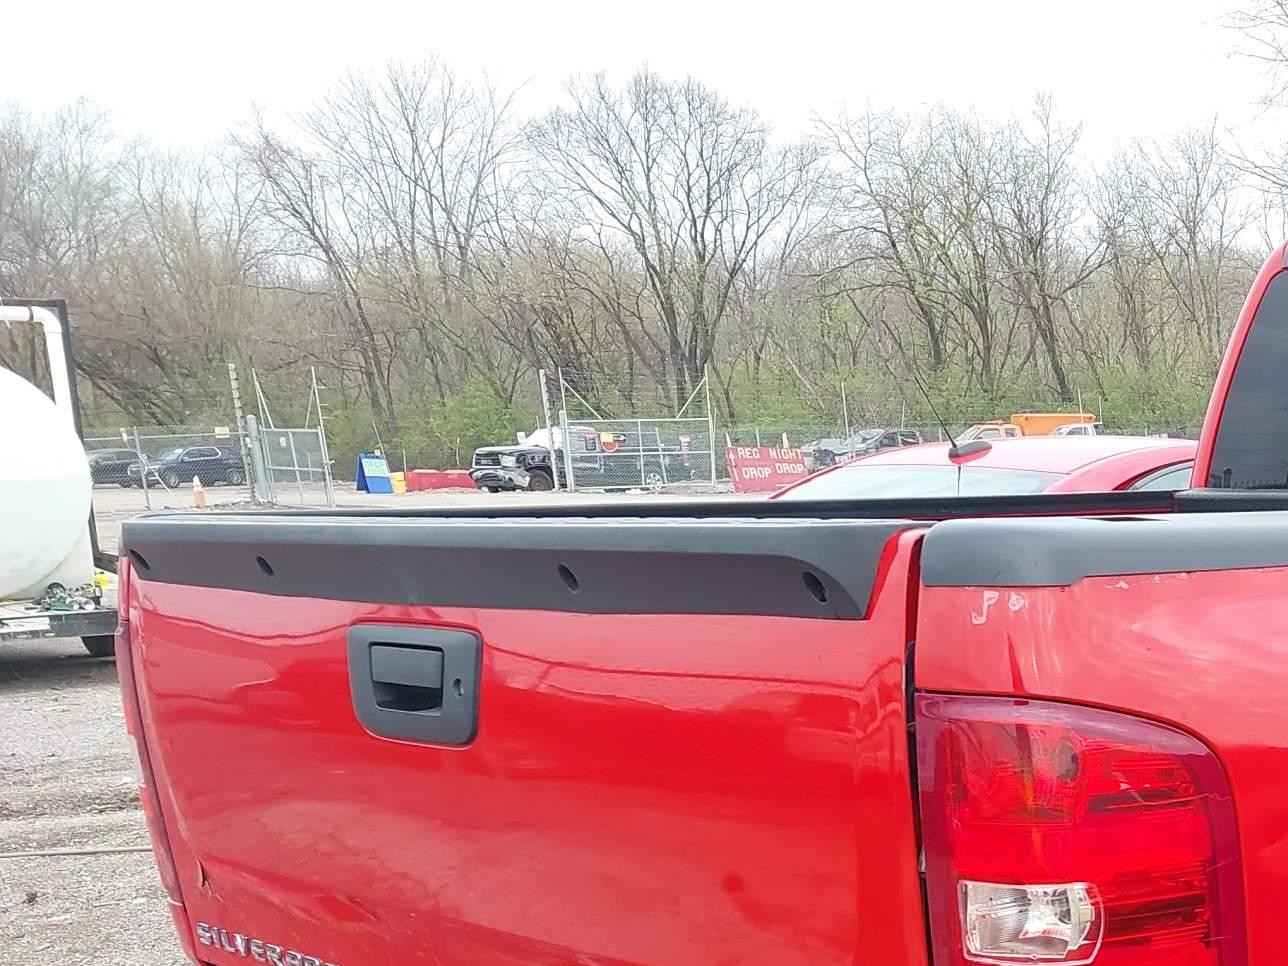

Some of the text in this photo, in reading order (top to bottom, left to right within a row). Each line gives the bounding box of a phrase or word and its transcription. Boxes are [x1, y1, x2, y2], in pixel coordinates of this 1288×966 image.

[768, 445, 802, 460] NIGHT
[742, 467, 771, 479] DROP
[775, 463, 804, 474] DROP
